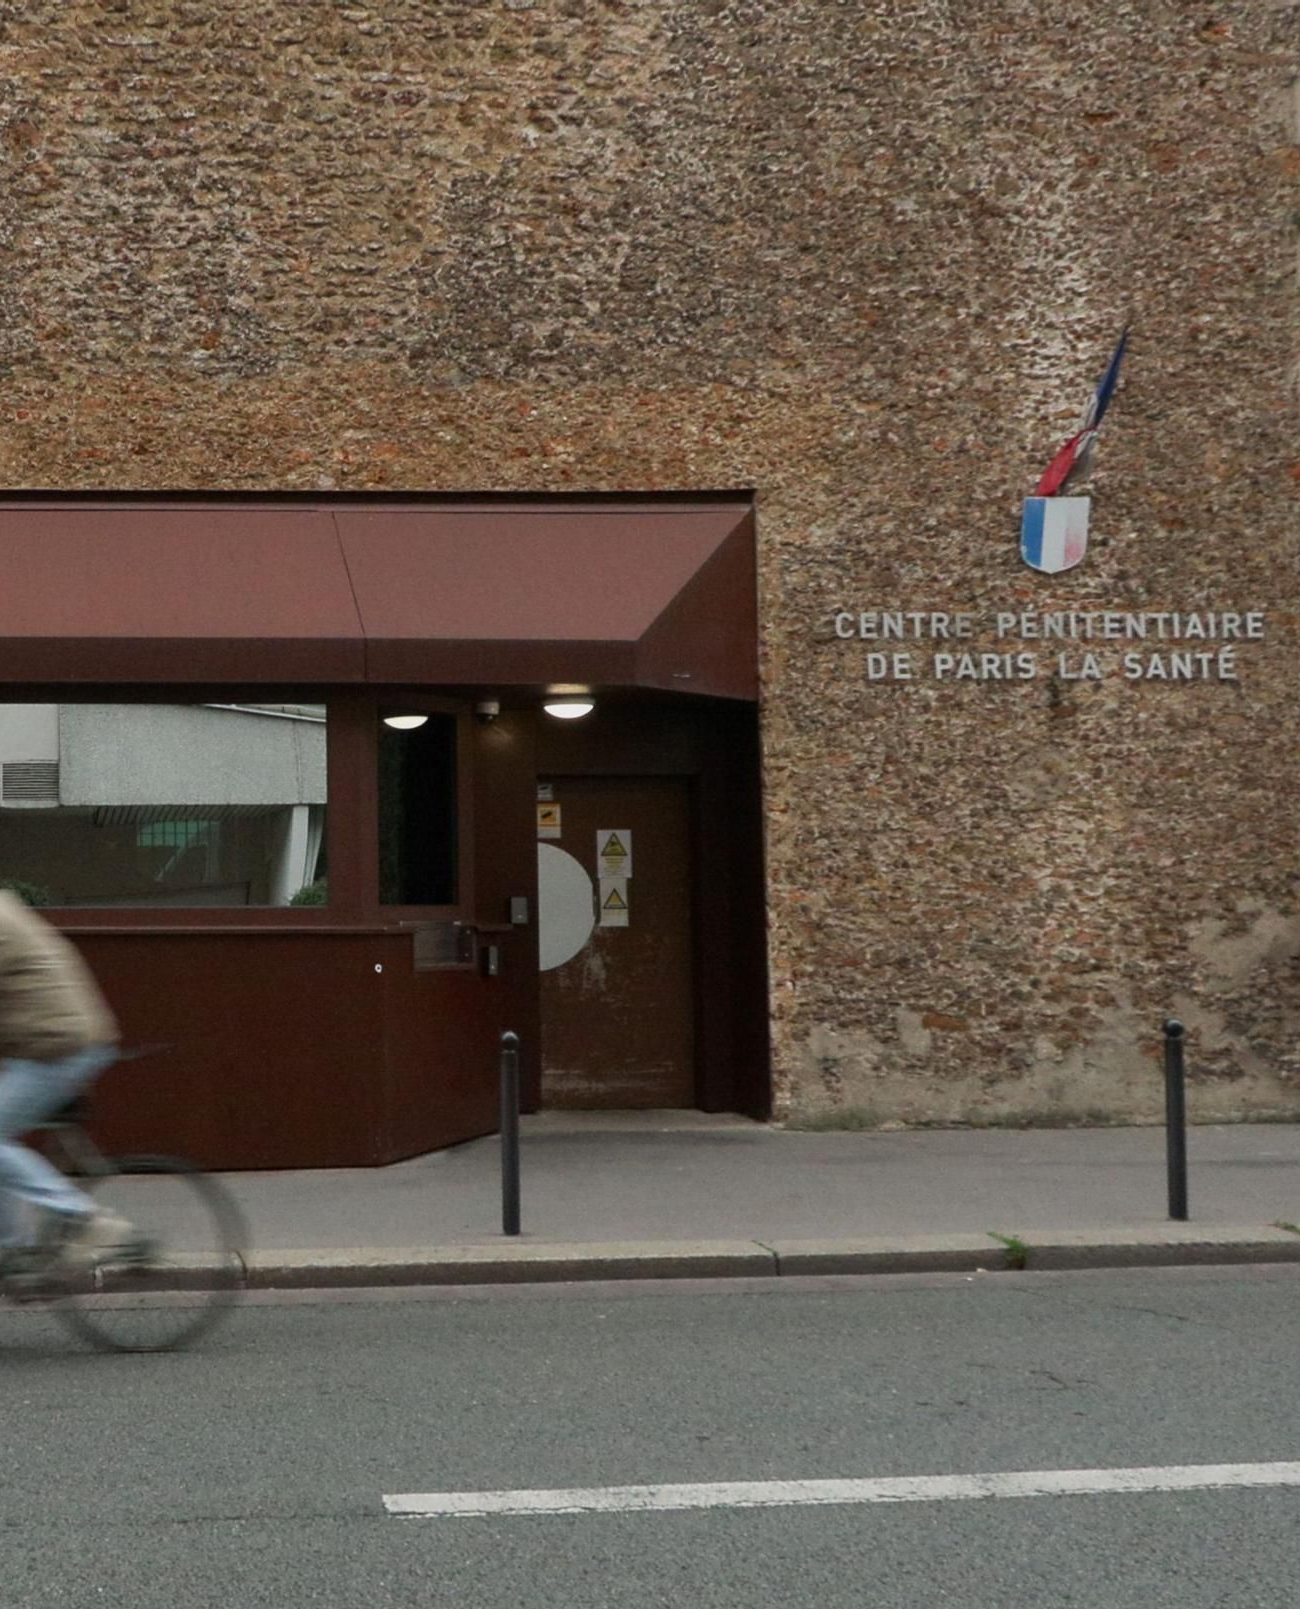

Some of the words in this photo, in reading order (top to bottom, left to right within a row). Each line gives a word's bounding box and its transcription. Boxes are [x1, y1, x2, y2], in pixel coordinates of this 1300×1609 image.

[834, 612, 974, 640] CENTRE
[997, 605, 1265, 640] PÉNITENTIAIRE
[867, 653, 911, 679] DE
[934, 652, 1037, 679] PARIS
[1059, 653, 1101, 679] LA
[1124, 646, 1238, 680] SANTÉ
